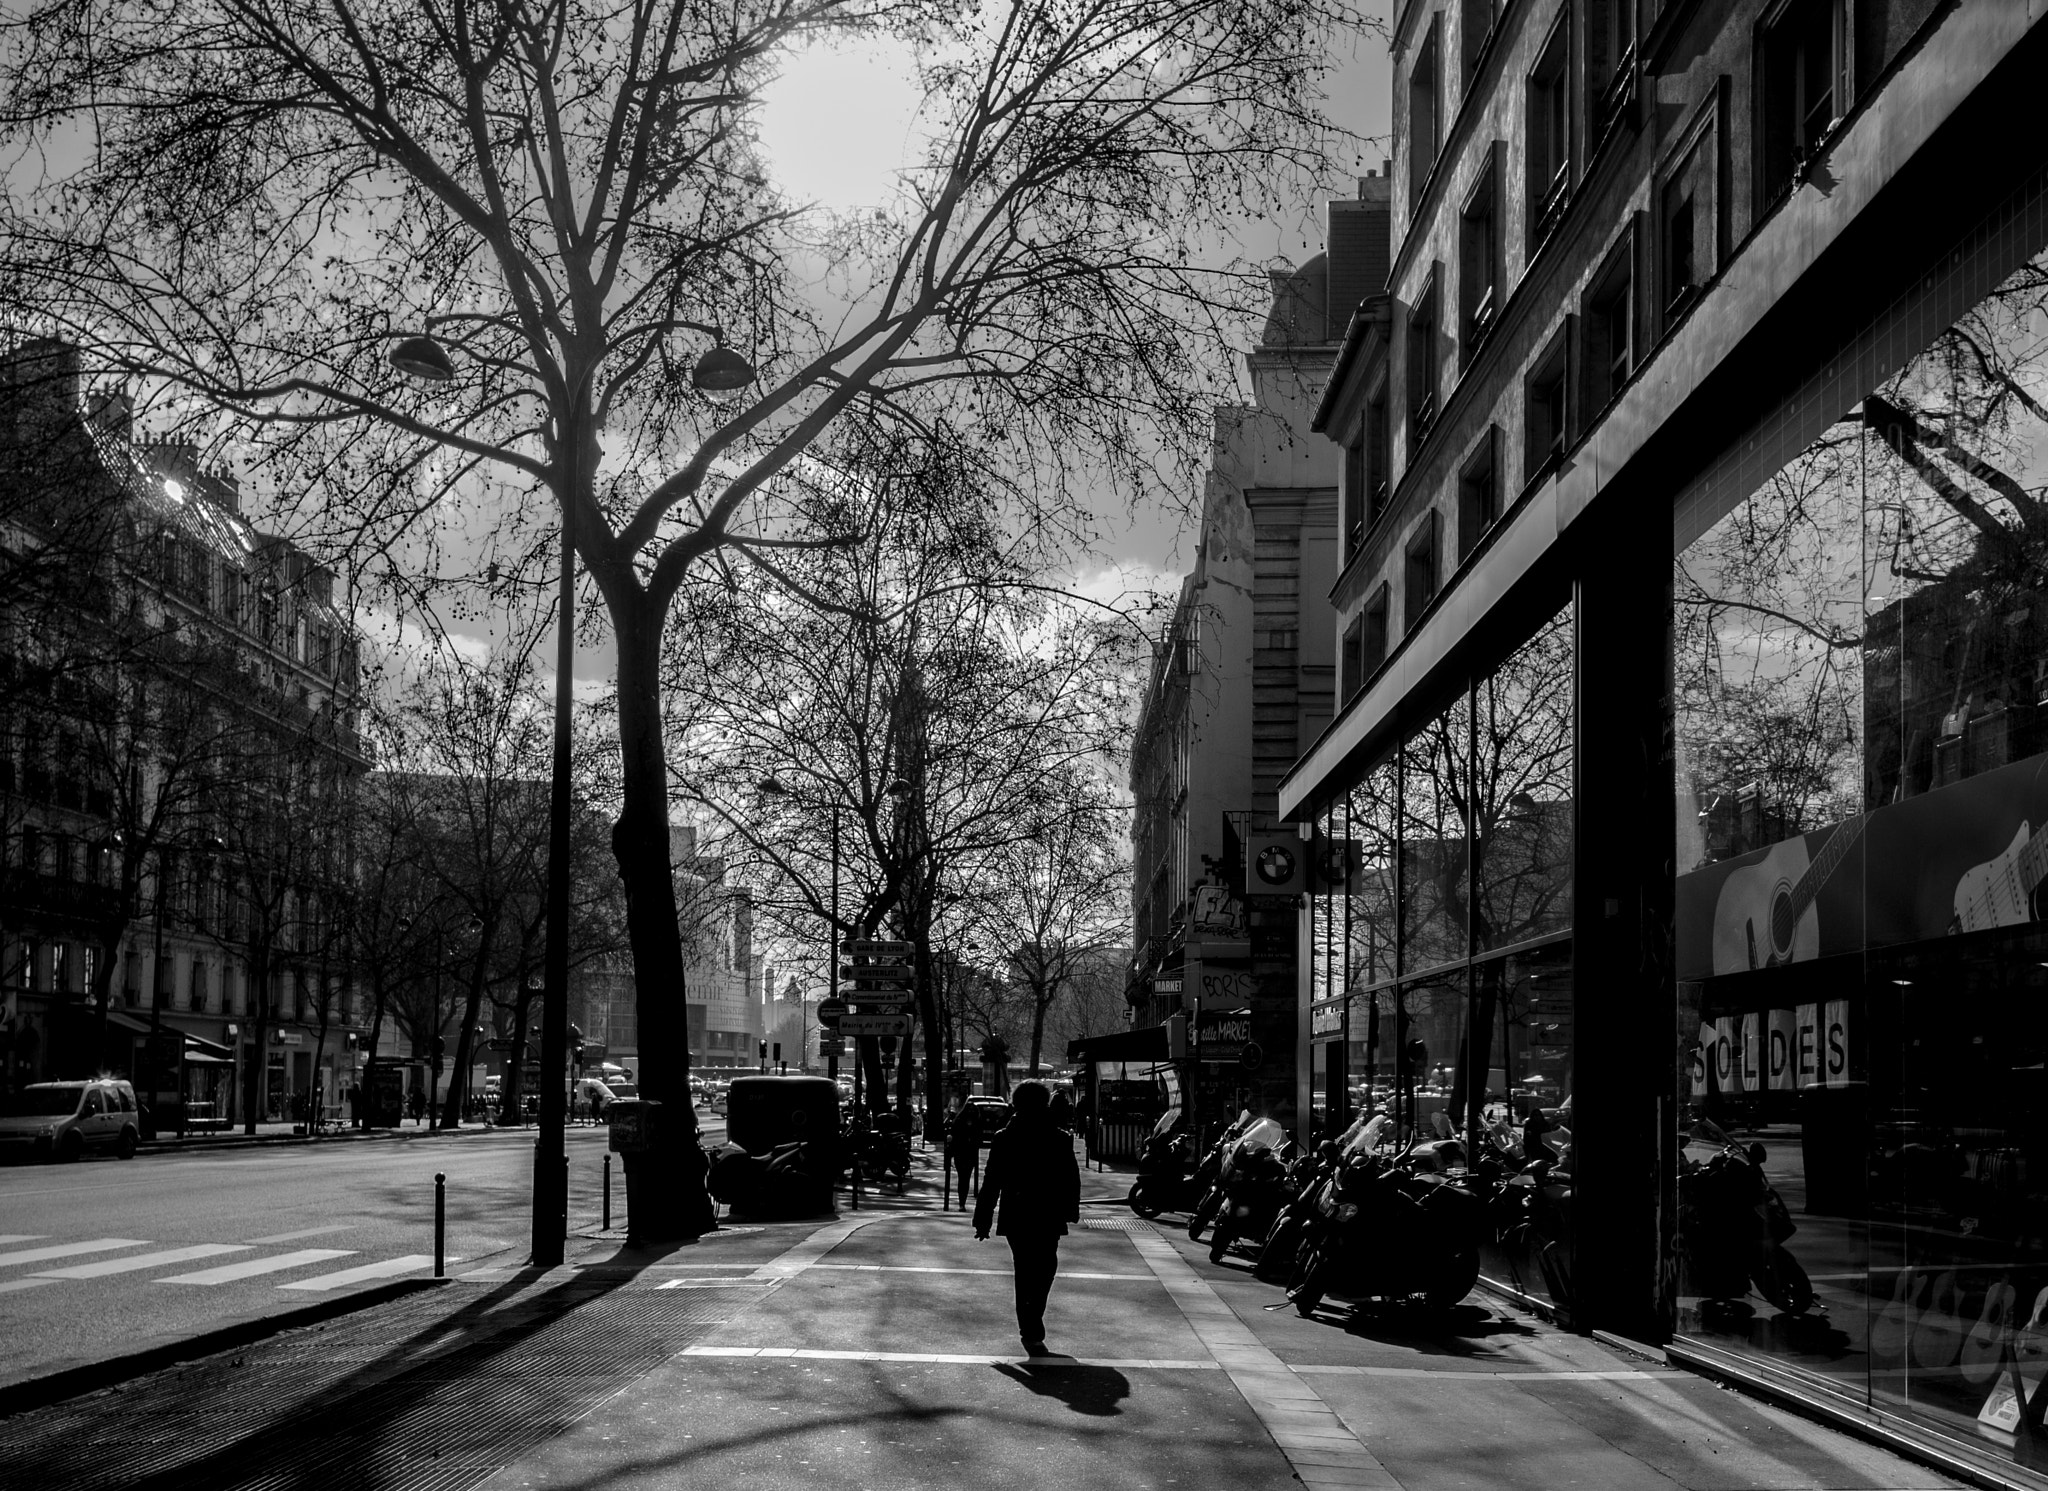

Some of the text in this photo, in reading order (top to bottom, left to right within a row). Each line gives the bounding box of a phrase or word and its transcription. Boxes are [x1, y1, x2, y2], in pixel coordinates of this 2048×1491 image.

[858, 969, 898, 977] AUSTERLITZ
[1154, 980, 1182, 993] MARKET
[1187, 1019, 1251, 1042] Bstille MARKET
[1692, 1022, 1845, 1084] SOLDES
